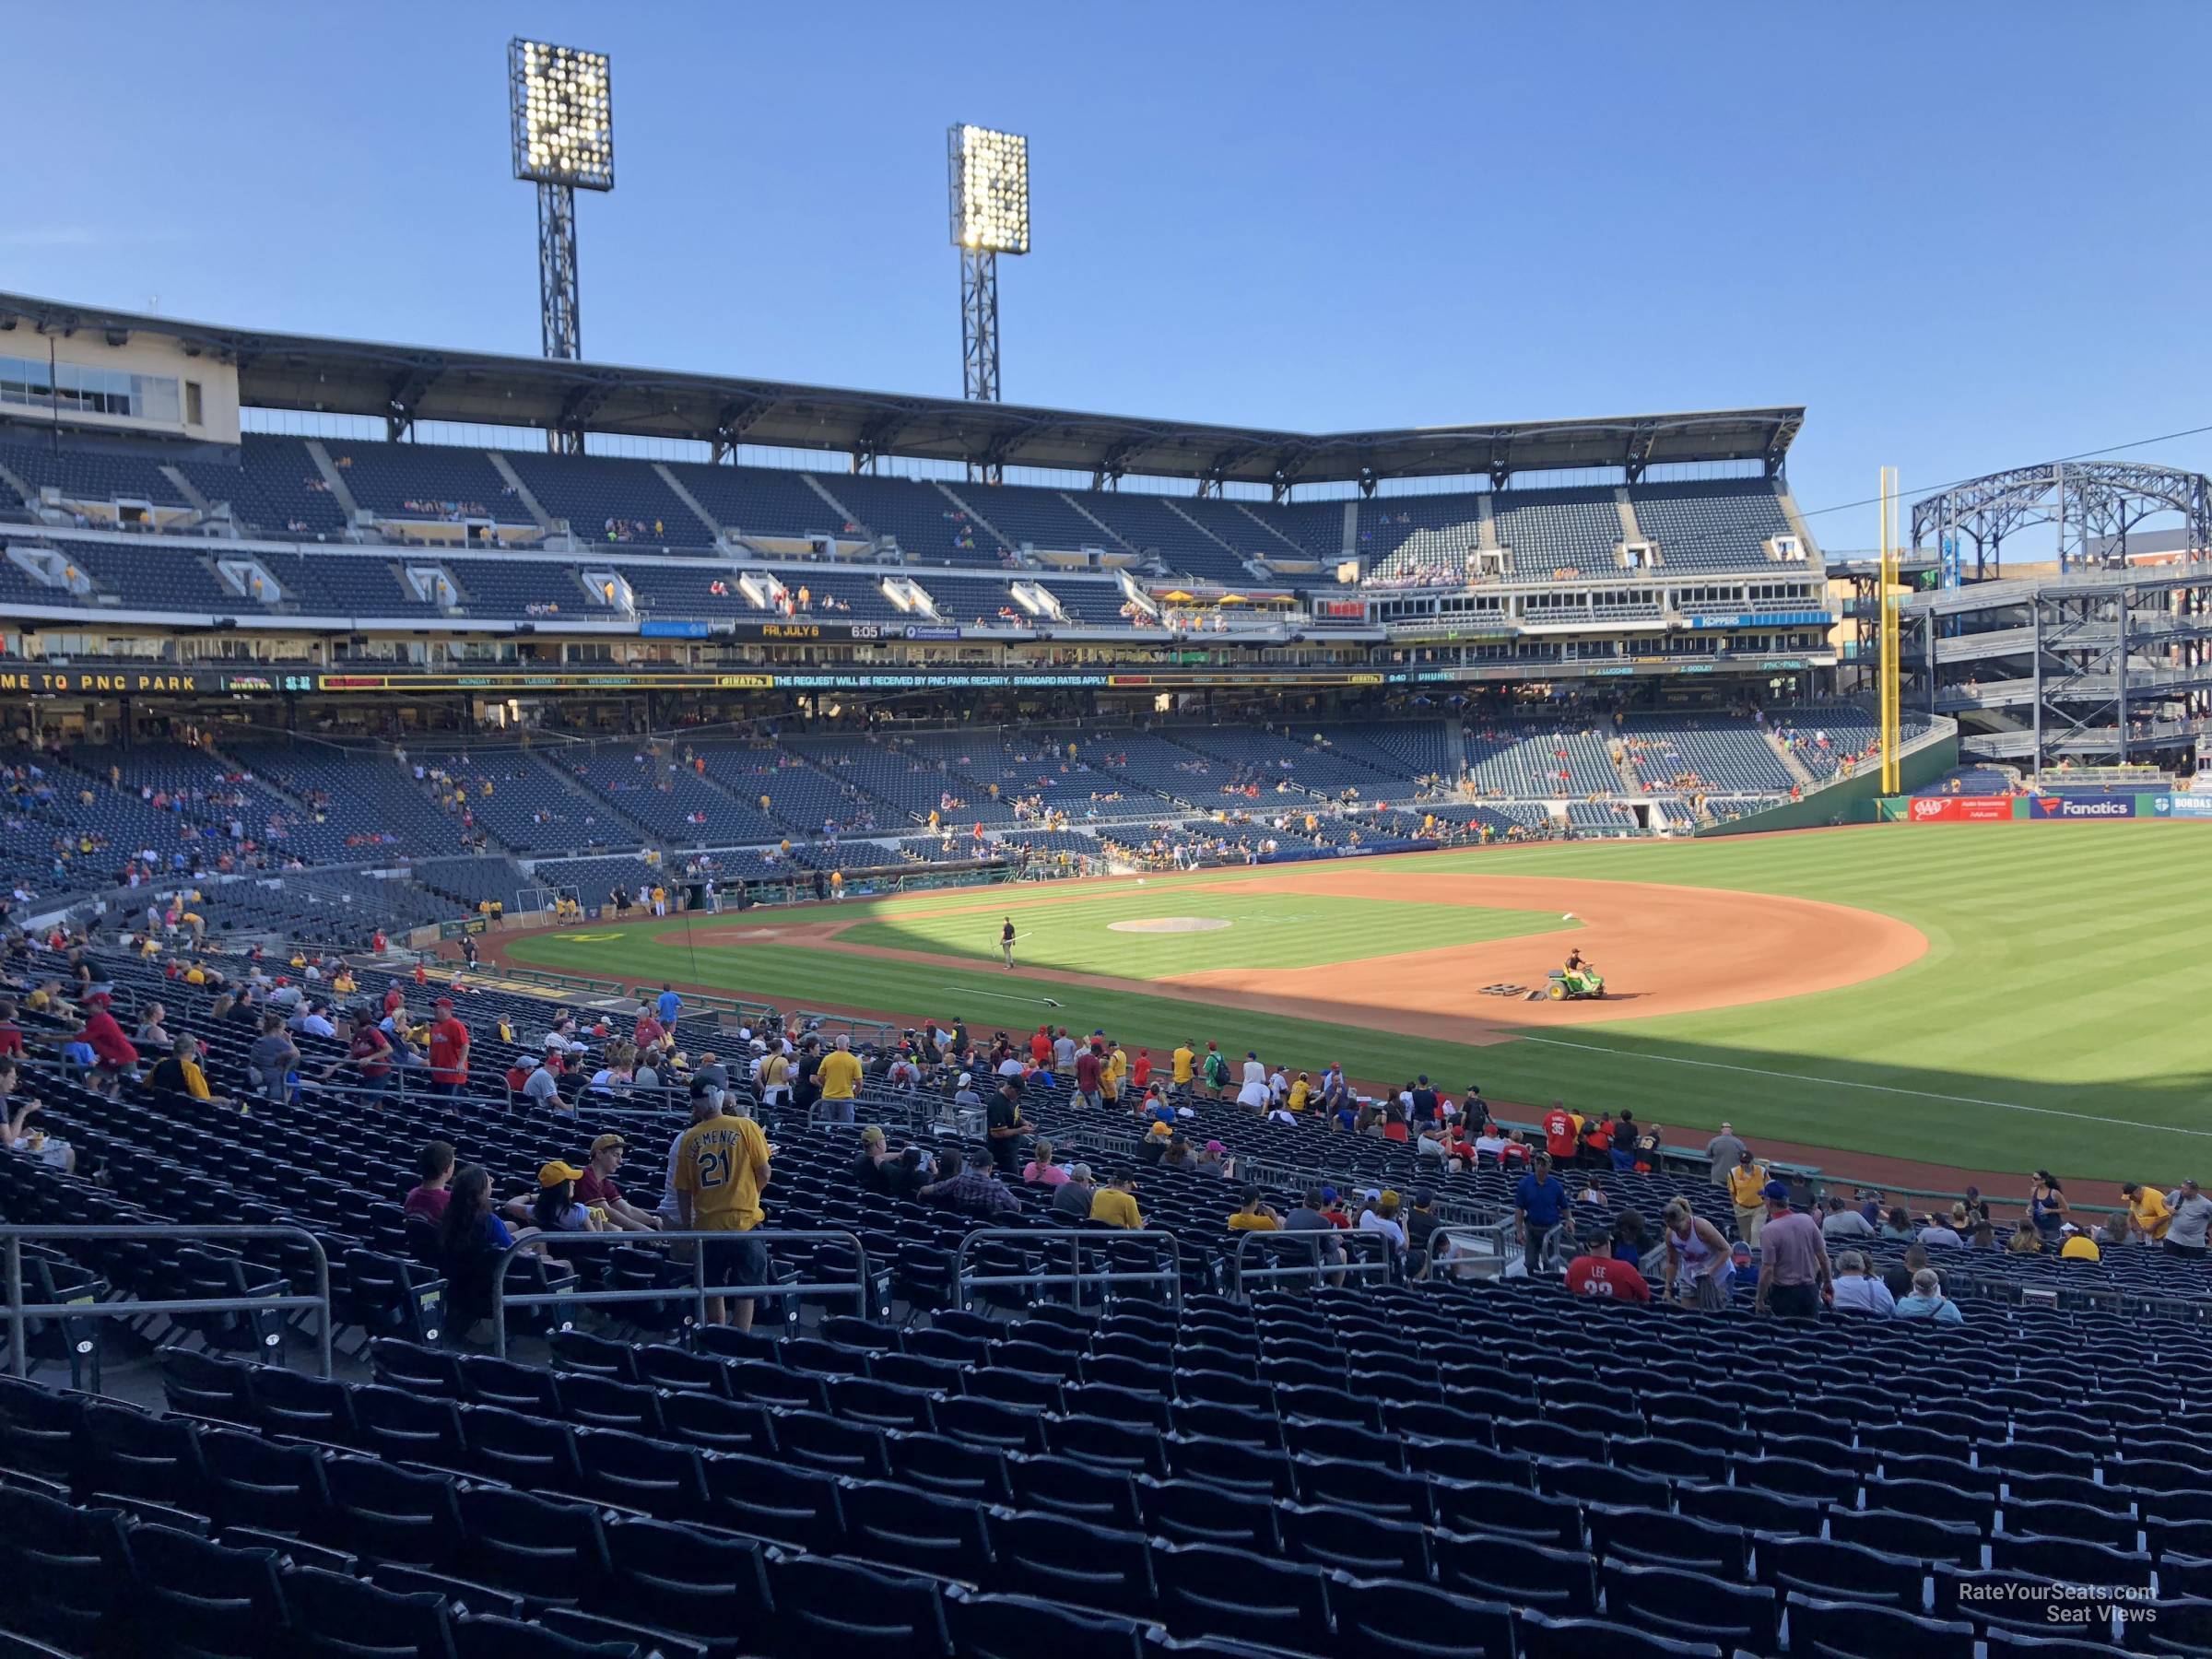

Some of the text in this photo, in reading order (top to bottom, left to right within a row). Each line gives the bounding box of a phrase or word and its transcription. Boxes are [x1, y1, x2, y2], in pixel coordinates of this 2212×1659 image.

[1702, 616, 1739, 626] KOPPERS
[783, 626, 809, 636] JULY
[811, 626, 819, 636] 6
[852, 626, 877, 637] 6:05
[42, 675, 67, 689] TO
[81, 676, 126, 689] PNC
[139, 677, 194, 690] PARK
[774, 677, 793, 687] THE
[794, 677, 835, 687] REQUEST
[837, 677, 859, 686] WILL
[860, 677, 871, 686] BE
[873, 677, 913, 686] RECEIVED
[914, 677, 927, 686] BY
[928, 677, 947, 686] PNC
[947, 677, 970, 686] PARK
[1014, 677, 1056, 686] STANDARD
[1057, 677, 1081, 685] RATES
[1082, 677, 1108, 685] APPLY.
[2063, 801, 2128, 815] Fanatics
[698, 1149, 730, 1188] 21
[1592, 1265, 1606, 1278] LEE
